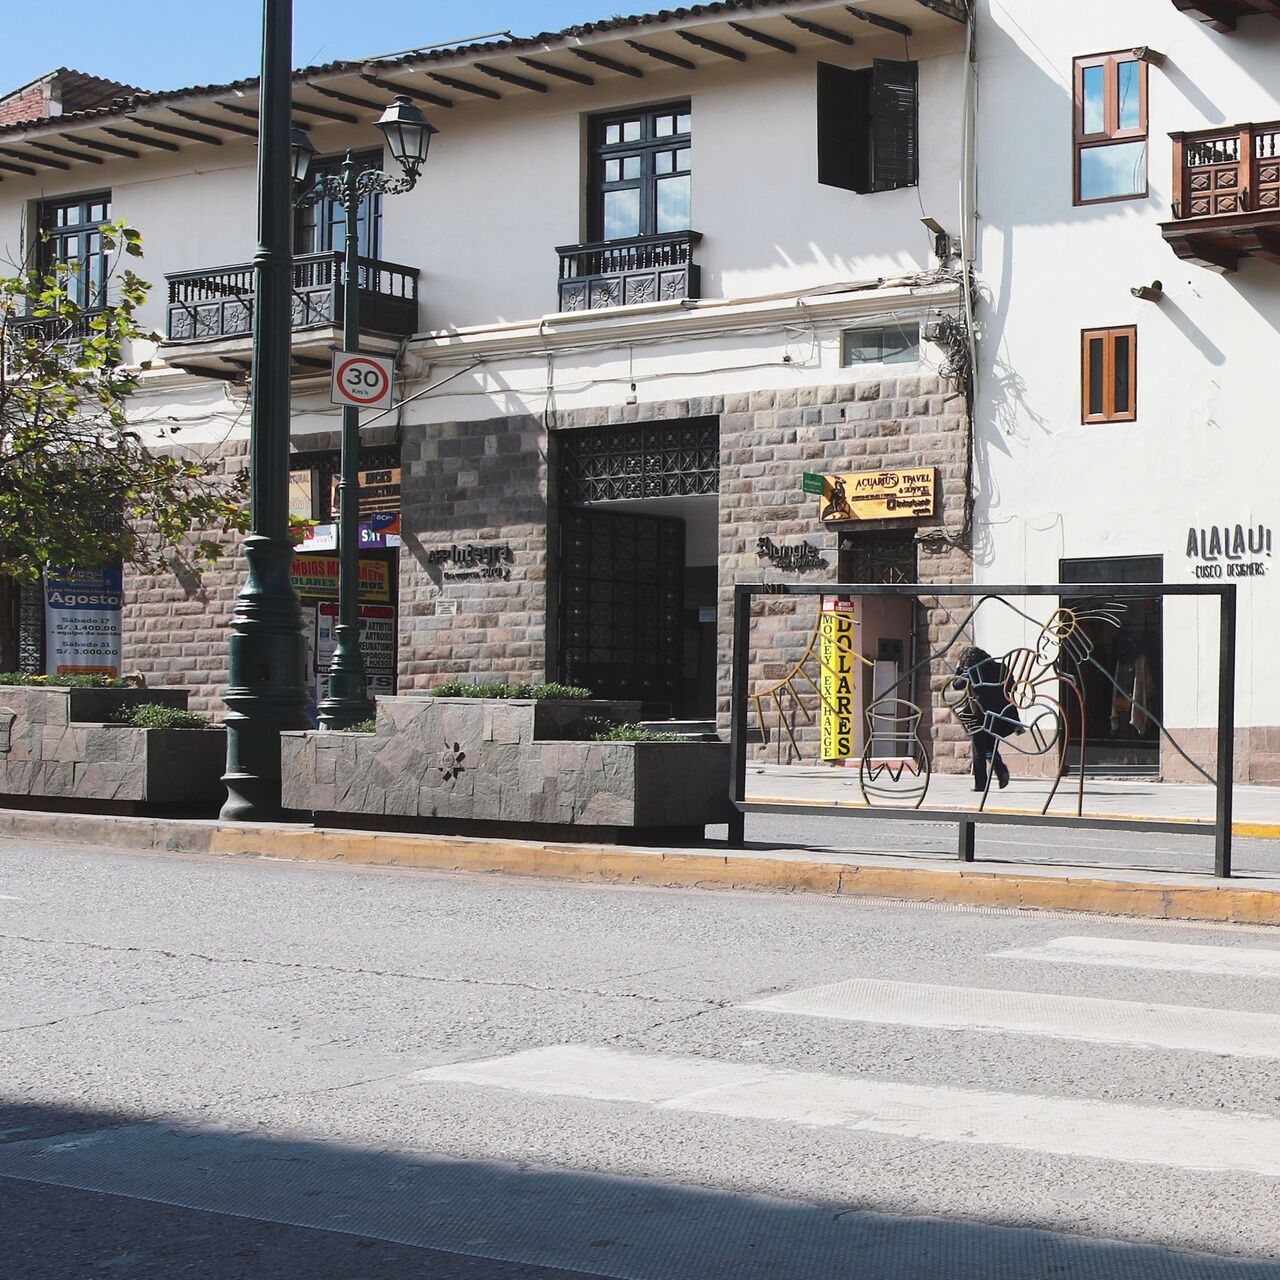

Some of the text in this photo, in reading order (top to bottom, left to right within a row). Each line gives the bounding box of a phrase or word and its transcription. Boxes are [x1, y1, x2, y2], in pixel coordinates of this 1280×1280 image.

[347, 368, 379, 387] 30
[902, 474, 932, 487] TRAVEL
[1186, 524, 1271, 561] ALALAU!
[450, 544, 507, 566] Integra
[292, 577, 336, 587] OLARES
[836, 614, 852, 756] DOLARES
